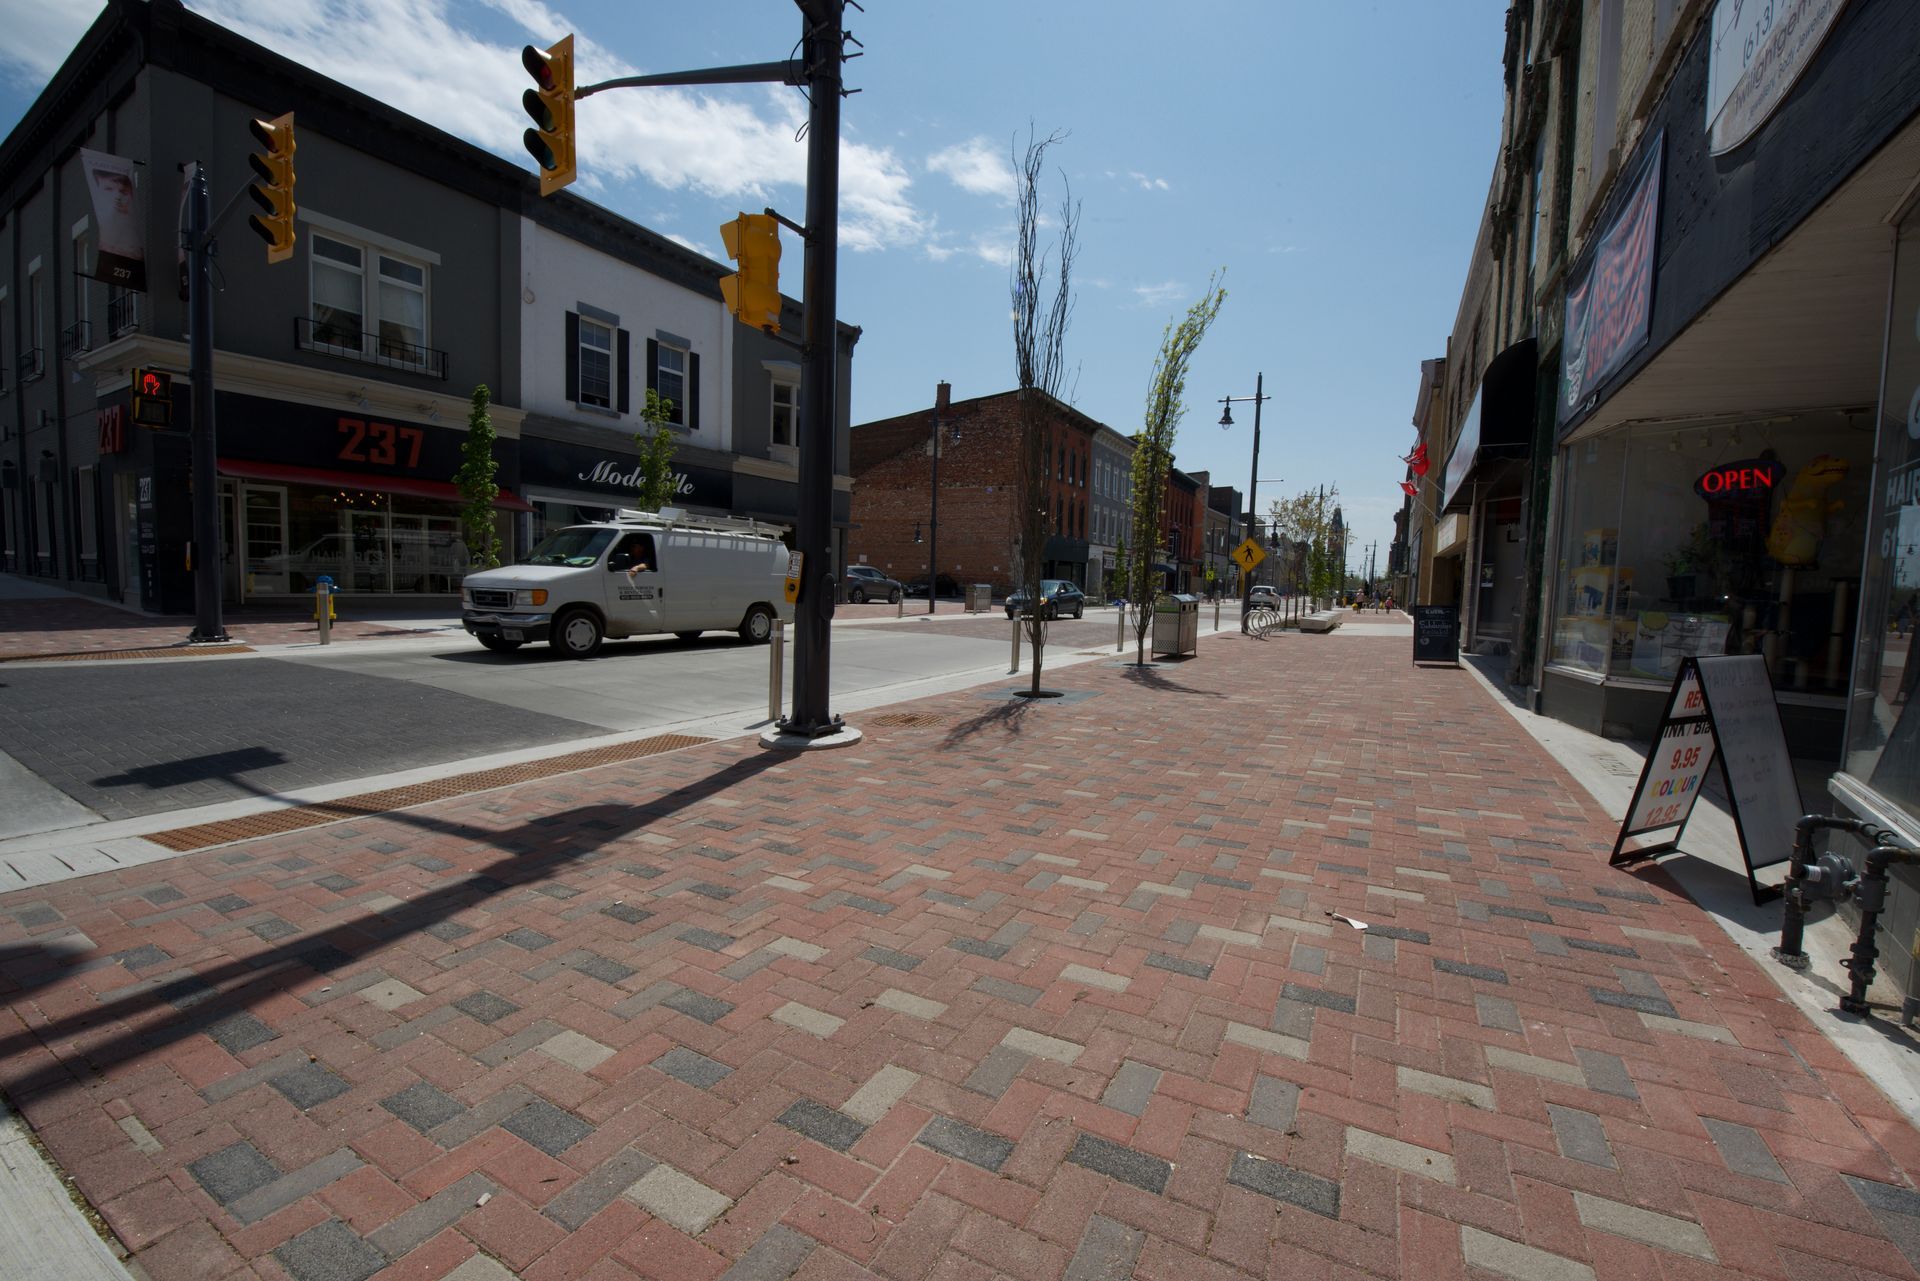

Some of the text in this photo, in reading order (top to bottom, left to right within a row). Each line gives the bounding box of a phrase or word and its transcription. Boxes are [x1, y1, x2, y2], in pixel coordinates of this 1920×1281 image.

[113, 266, 131, 281] 237
[97, 404, 122, 455] 237
[336, 417, 425, 469] 237
[578, 460, 648, 488] Mode
[1702, 466, 1773, 494] OPEN
[139, 477, 152, 502] 237
[1671, 746, 1702, 770] 9.95
[1650, 773, 1699, 798] COLOUR
[1643, 803, 1682, 828] 12.95
